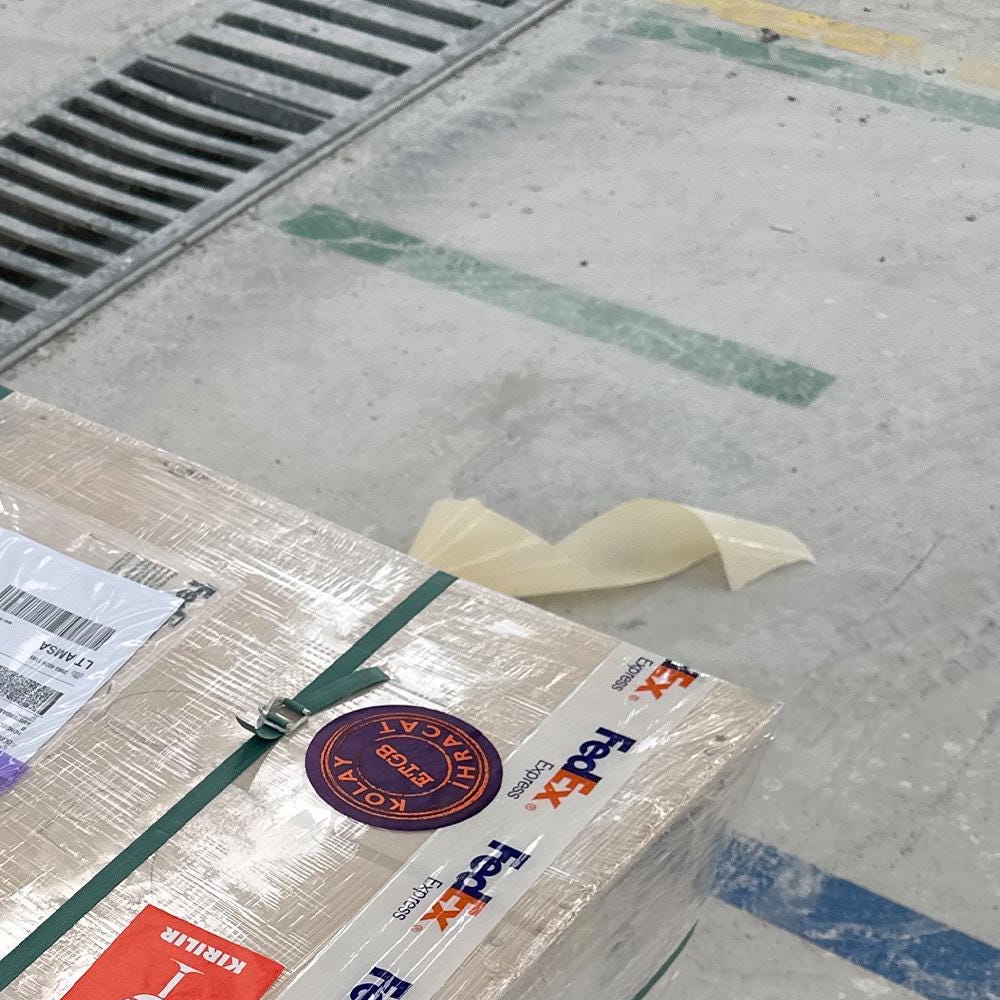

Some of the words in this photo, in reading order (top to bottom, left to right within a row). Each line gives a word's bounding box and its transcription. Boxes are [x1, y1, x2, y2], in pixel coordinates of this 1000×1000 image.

[39, 641, 77, 662] AMSA
[74, 657, 94, 670] LT
[612, 656, 654, 692] Express
[334, 755, 406, 812] KOLAY
[375, 744, 435, 788] ETGB
[507, 760, 554, 800] Express
[534, 727, 637, 809] FedEx
[393, 877, 443, 921] Express
[420, 840, 531, 932] FedEx
[159, 926, 248, 975] KIRILIR
